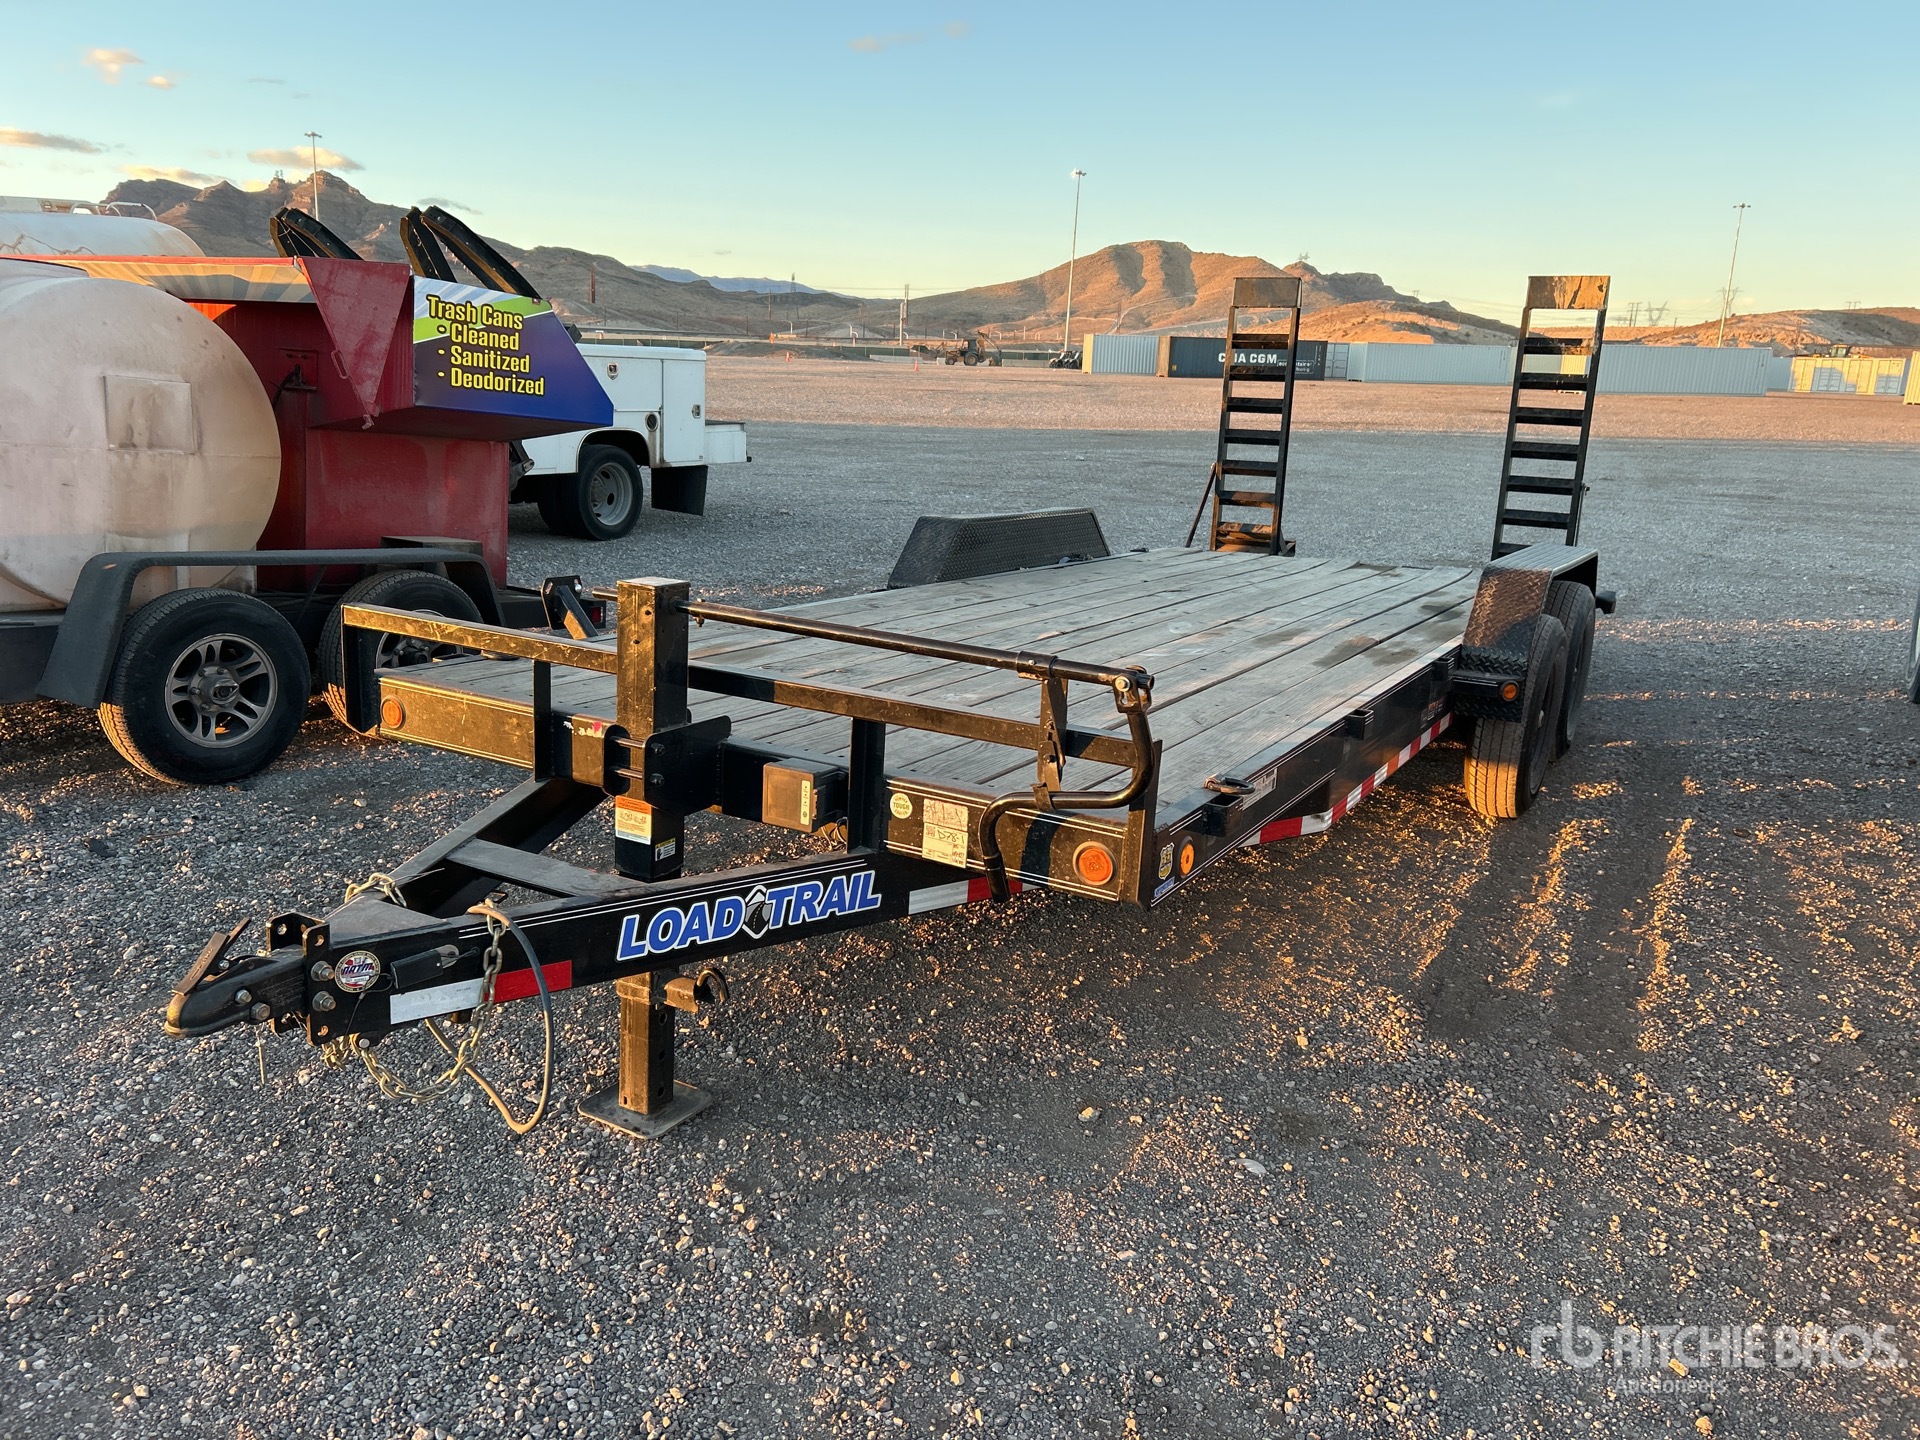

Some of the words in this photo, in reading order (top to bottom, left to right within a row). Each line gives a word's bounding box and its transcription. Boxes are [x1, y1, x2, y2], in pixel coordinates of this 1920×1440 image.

[427, 295, 477, 323] Trash
[481, 304, 524, 330] Cans
[451, 323, 520, 351] Cleaned
[450, 346, 531, 373] Sanitized
[1249, 353, 1278, 364] CGM
[450, 367, 545, 396] Deodorized
[616, 895, 747, 961] LOAD
[764, 870, 882, 930] TRAIL
